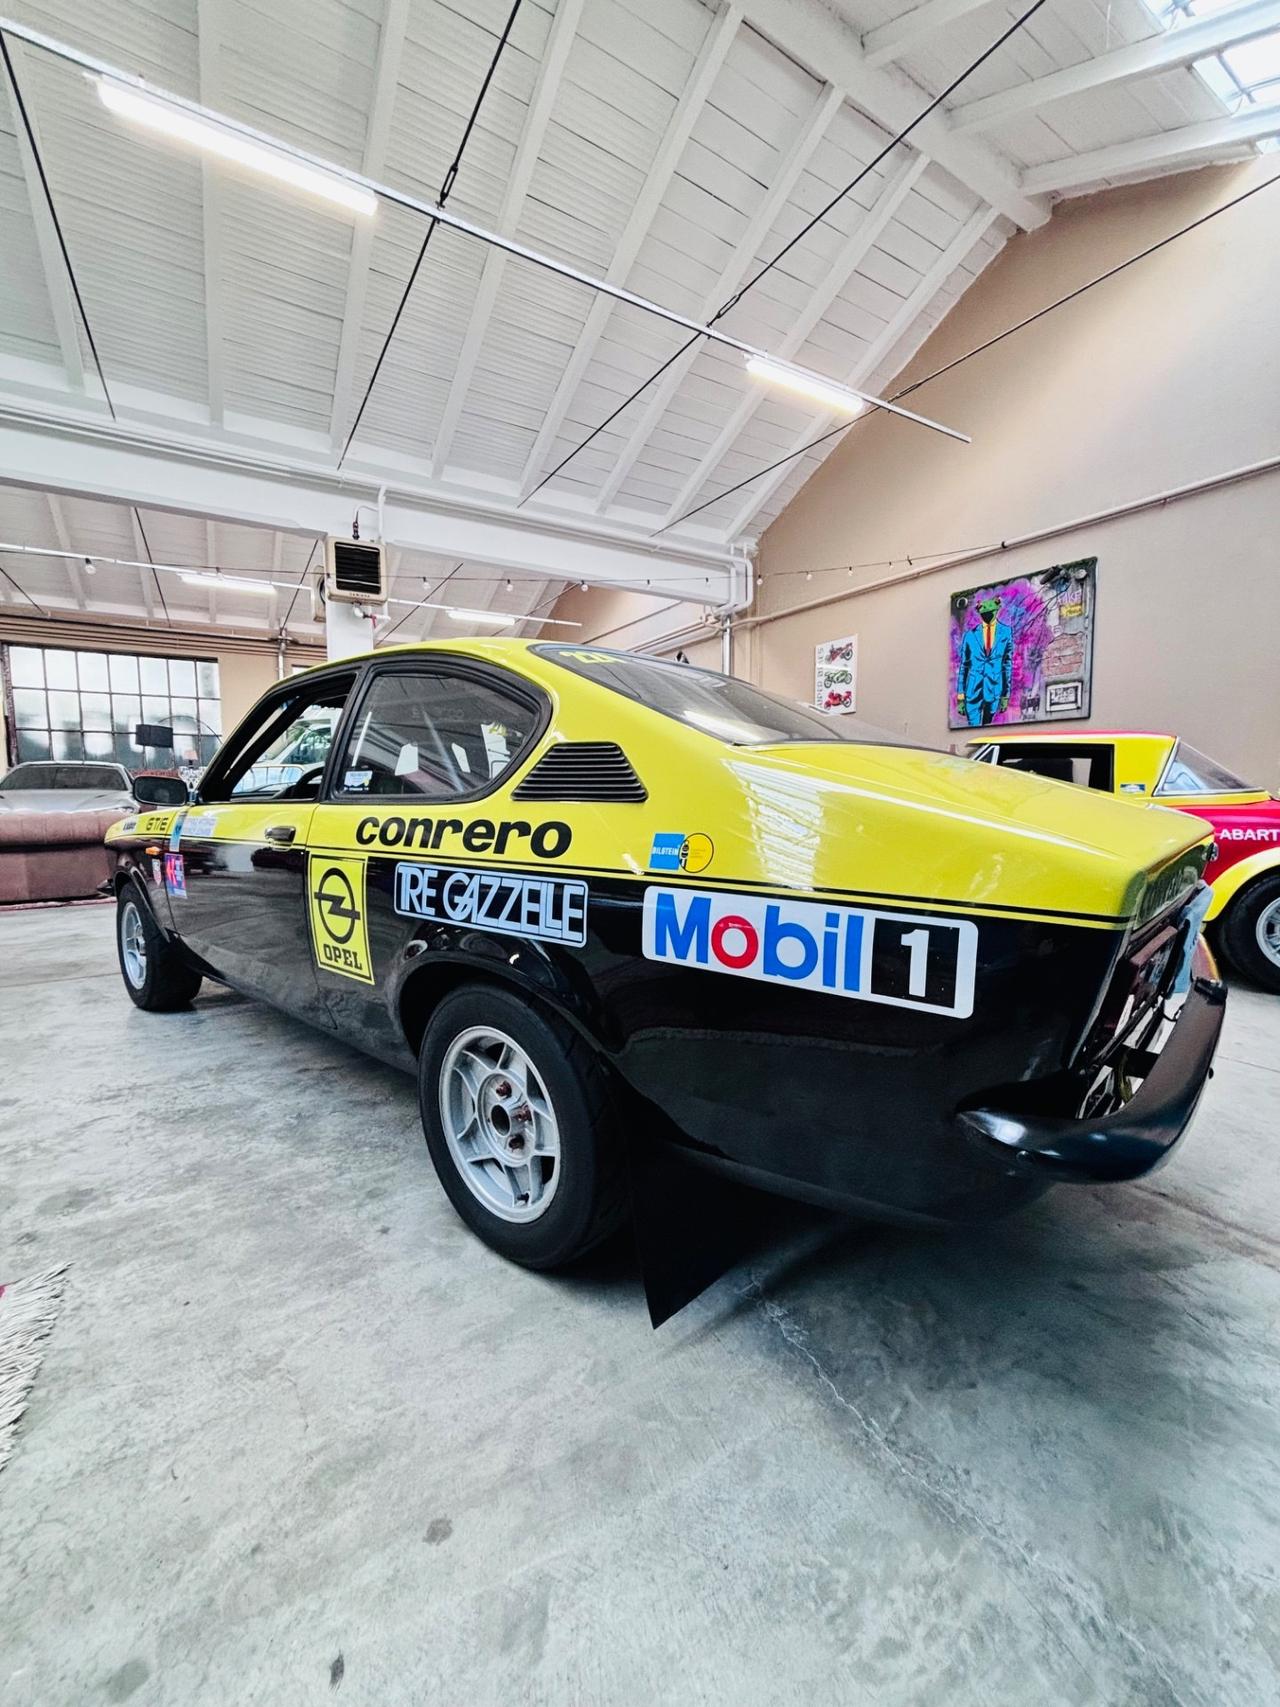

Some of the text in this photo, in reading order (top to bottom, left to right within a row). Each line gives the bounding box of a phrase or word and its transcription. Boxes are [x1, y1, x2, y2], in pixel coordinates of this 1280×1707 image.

[355, 816, 573, 859] conrero
[398, 865, 584, 943] TRE GAZZELLE
[323, 943, 363, 971] OPEL
[655, 893, 930, 998] Mobil 1
